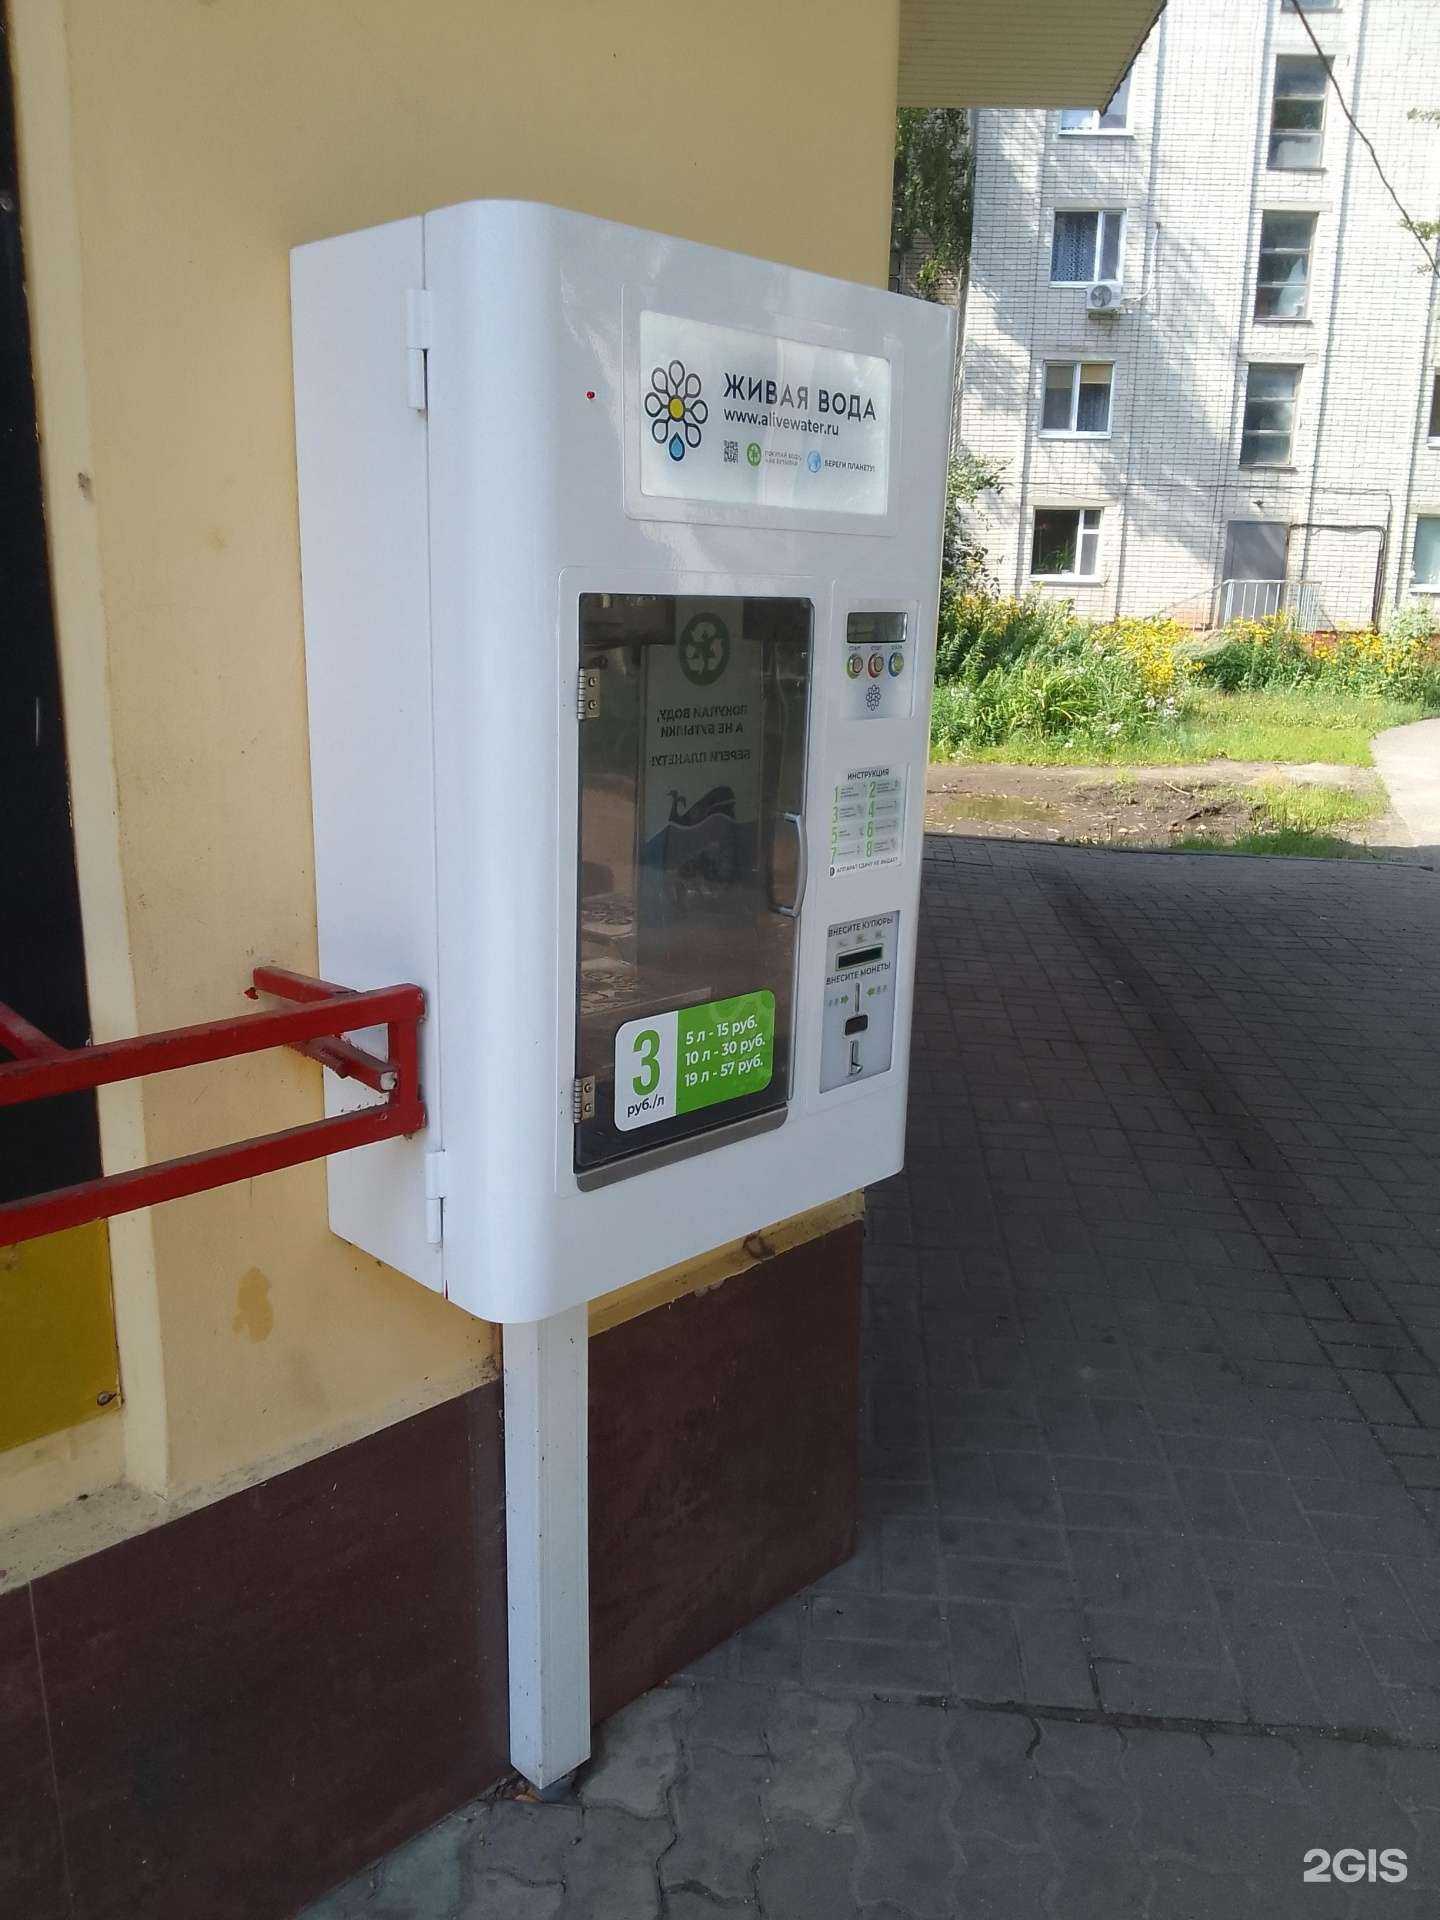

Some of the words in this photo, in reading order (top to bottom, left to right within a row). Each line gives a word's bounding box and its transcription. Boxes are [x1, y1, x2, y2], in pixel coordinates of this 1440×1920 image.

[723, 372, 808, 410] ЖИВАЯ
[818, 389, 876, 422] ВОДА
[723, 408, 839, 436] www.alivewater.ru
[847, 769, 889, 780] ИНСТРУКЦИЯ
[828, 923, 861, 937] ВНЕСИТЕ
[862, 917, 893, 928] КУПЮРЫ
[826, 971, 860, 985] ВНЕСИТЕ
[861, 962, 891, 976] МОНЕТЫ
[685, 1031, 694, 1045] 5
[696, 1031, 706, 1042] л
[716, 1022, 729, 1037] 15
[731, 1014, 758, 1034] руб.
[632, 1029, 661, 1096] 3
[684, 1052, 699, 1066] 10
[701, 1049, 711, 1062] л
[721, 1040, 737, 1056] 30
[740, 1033, 766, 1055] руб.
[684, 1072, 698, 1087] 19
[700, 1070, 710, 1083] л
[720, 1062, 735, 1077] 57
[738, 1053, 764, 1075] руб.
[627, 1095, 664, 1117] руб./л
